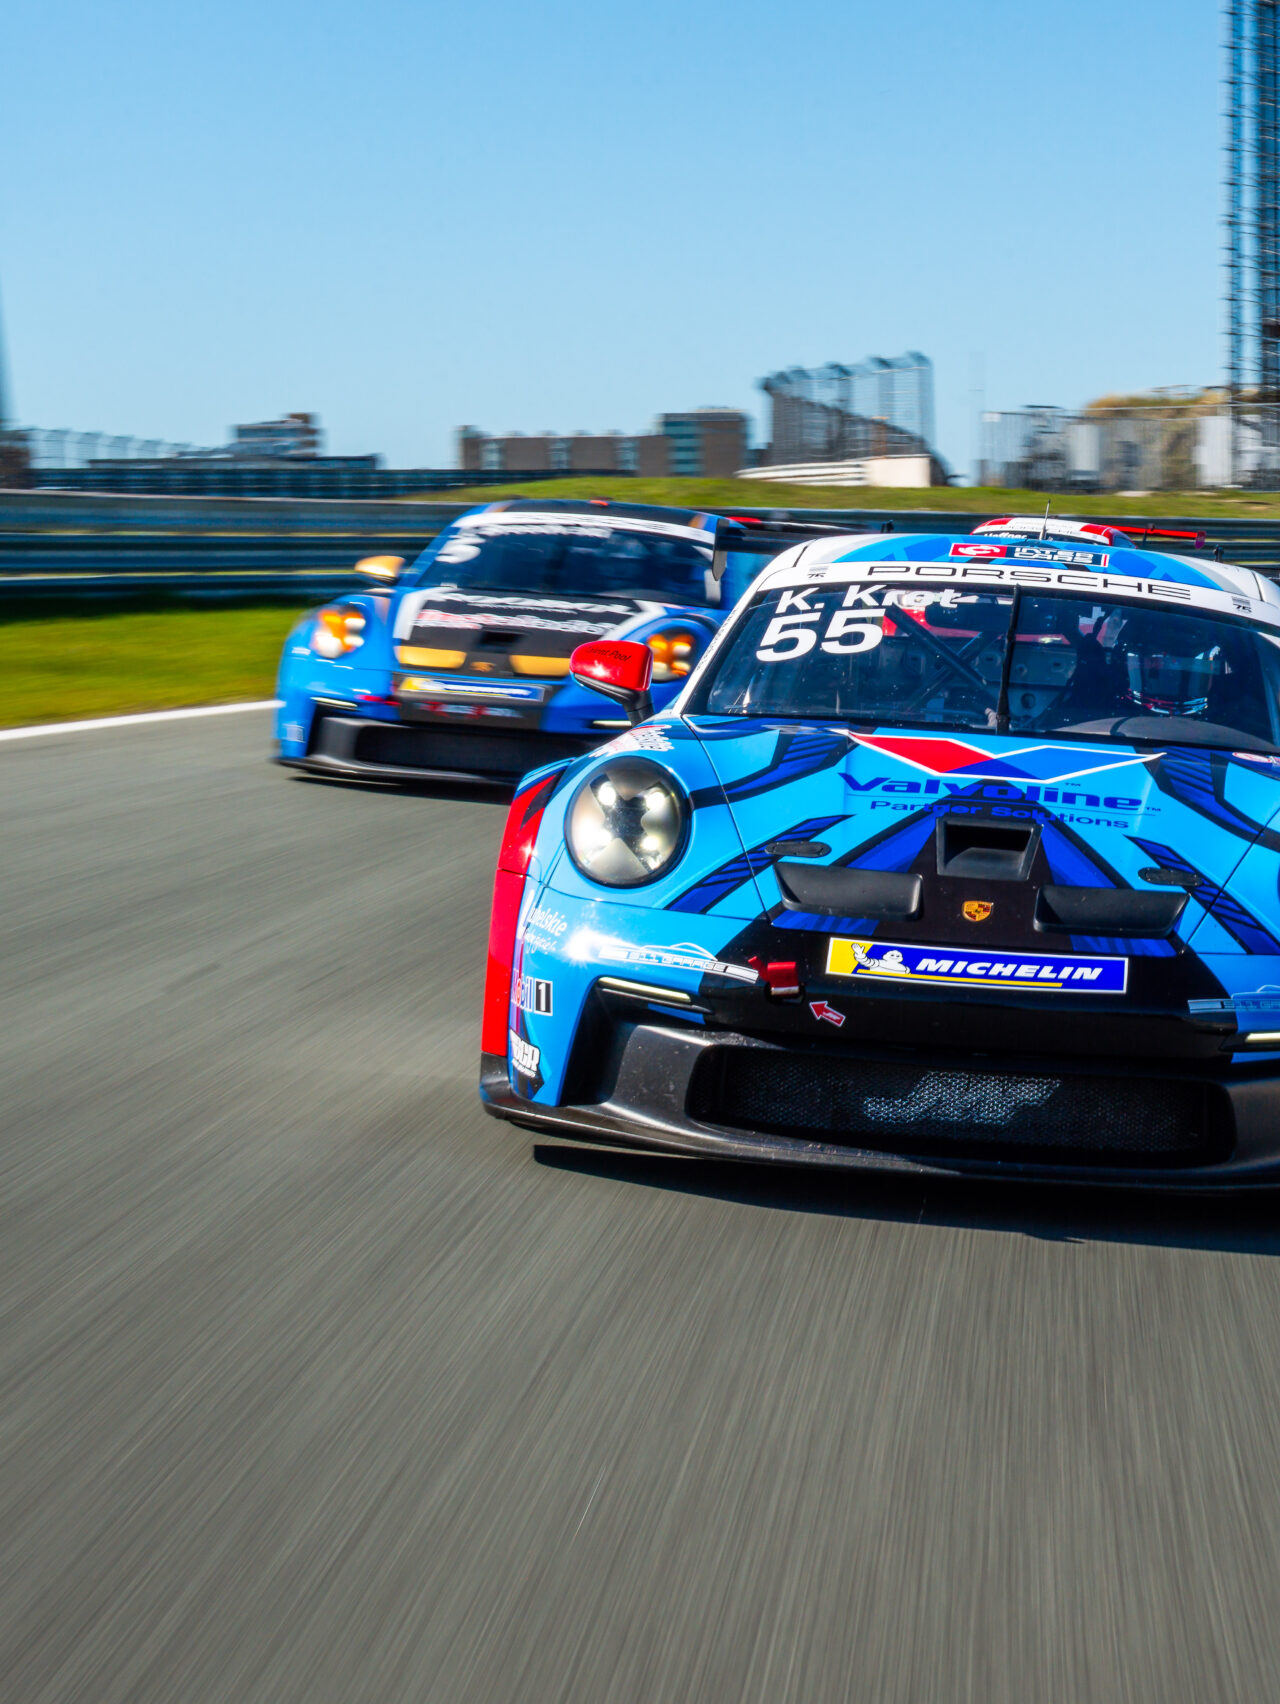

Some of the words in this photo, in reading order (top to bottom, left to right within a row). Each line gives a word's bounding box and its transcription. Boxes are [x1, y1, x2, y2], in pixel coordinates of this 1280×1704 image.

[867, 565, 1191, 600] PORSCHE
[775, 587, 826, 614] K.
[756, 608, 887, 662] 55
[837, 772, 1143, 812] Valvoline
[870, 799, 983, 817] Partner
[990, 804, 1130, 830] Solutions
[915, 957, 1103, 982] MICHELIN
